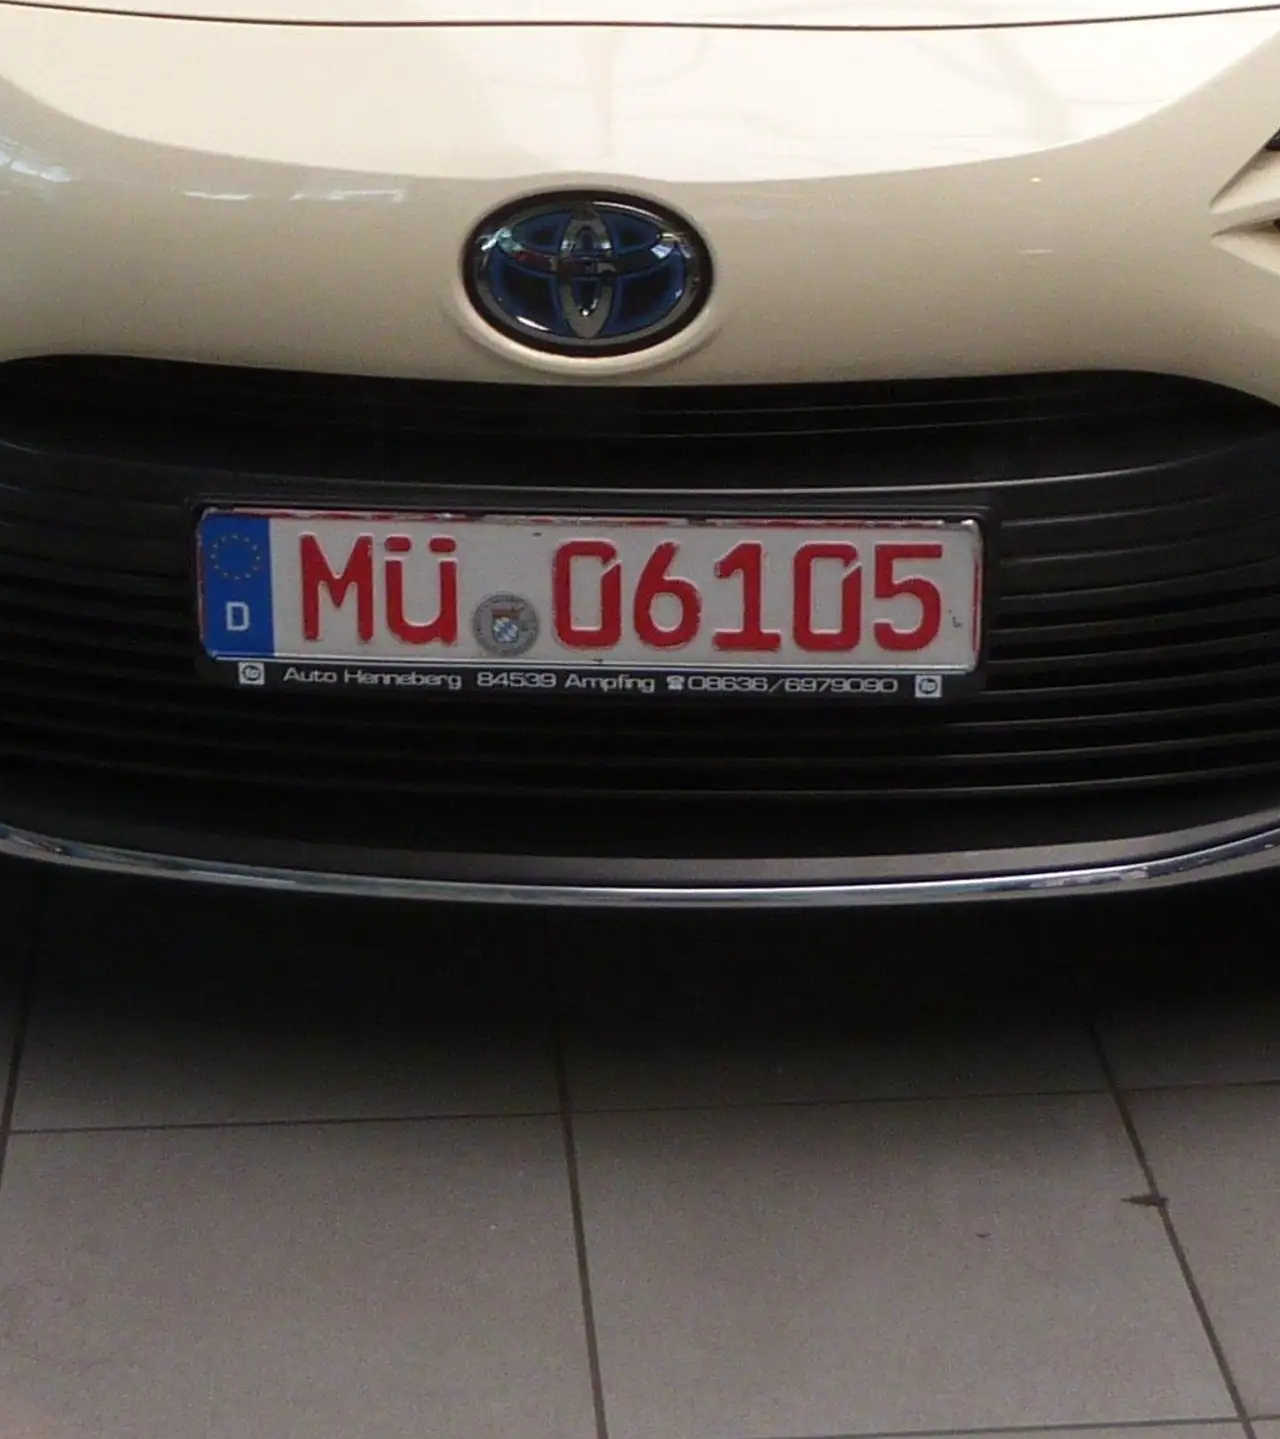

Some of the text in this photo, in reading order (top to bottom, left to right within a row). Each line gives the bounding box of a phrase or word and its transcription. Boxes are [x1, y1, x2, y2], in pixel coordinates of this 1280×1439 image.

[299, 534, 458, 644] MÜ
[552, 540, 943, 651] 06105
[226, 603, 250, 631] D
[283, 666, 337, 683] Auto
[344, 669, 462, 690] Henneberg
[477, 672, 557, 688] 84539
[565, 673, 655, 693] Ampfing
[687, 675, 898, 694] 08636/6979090
